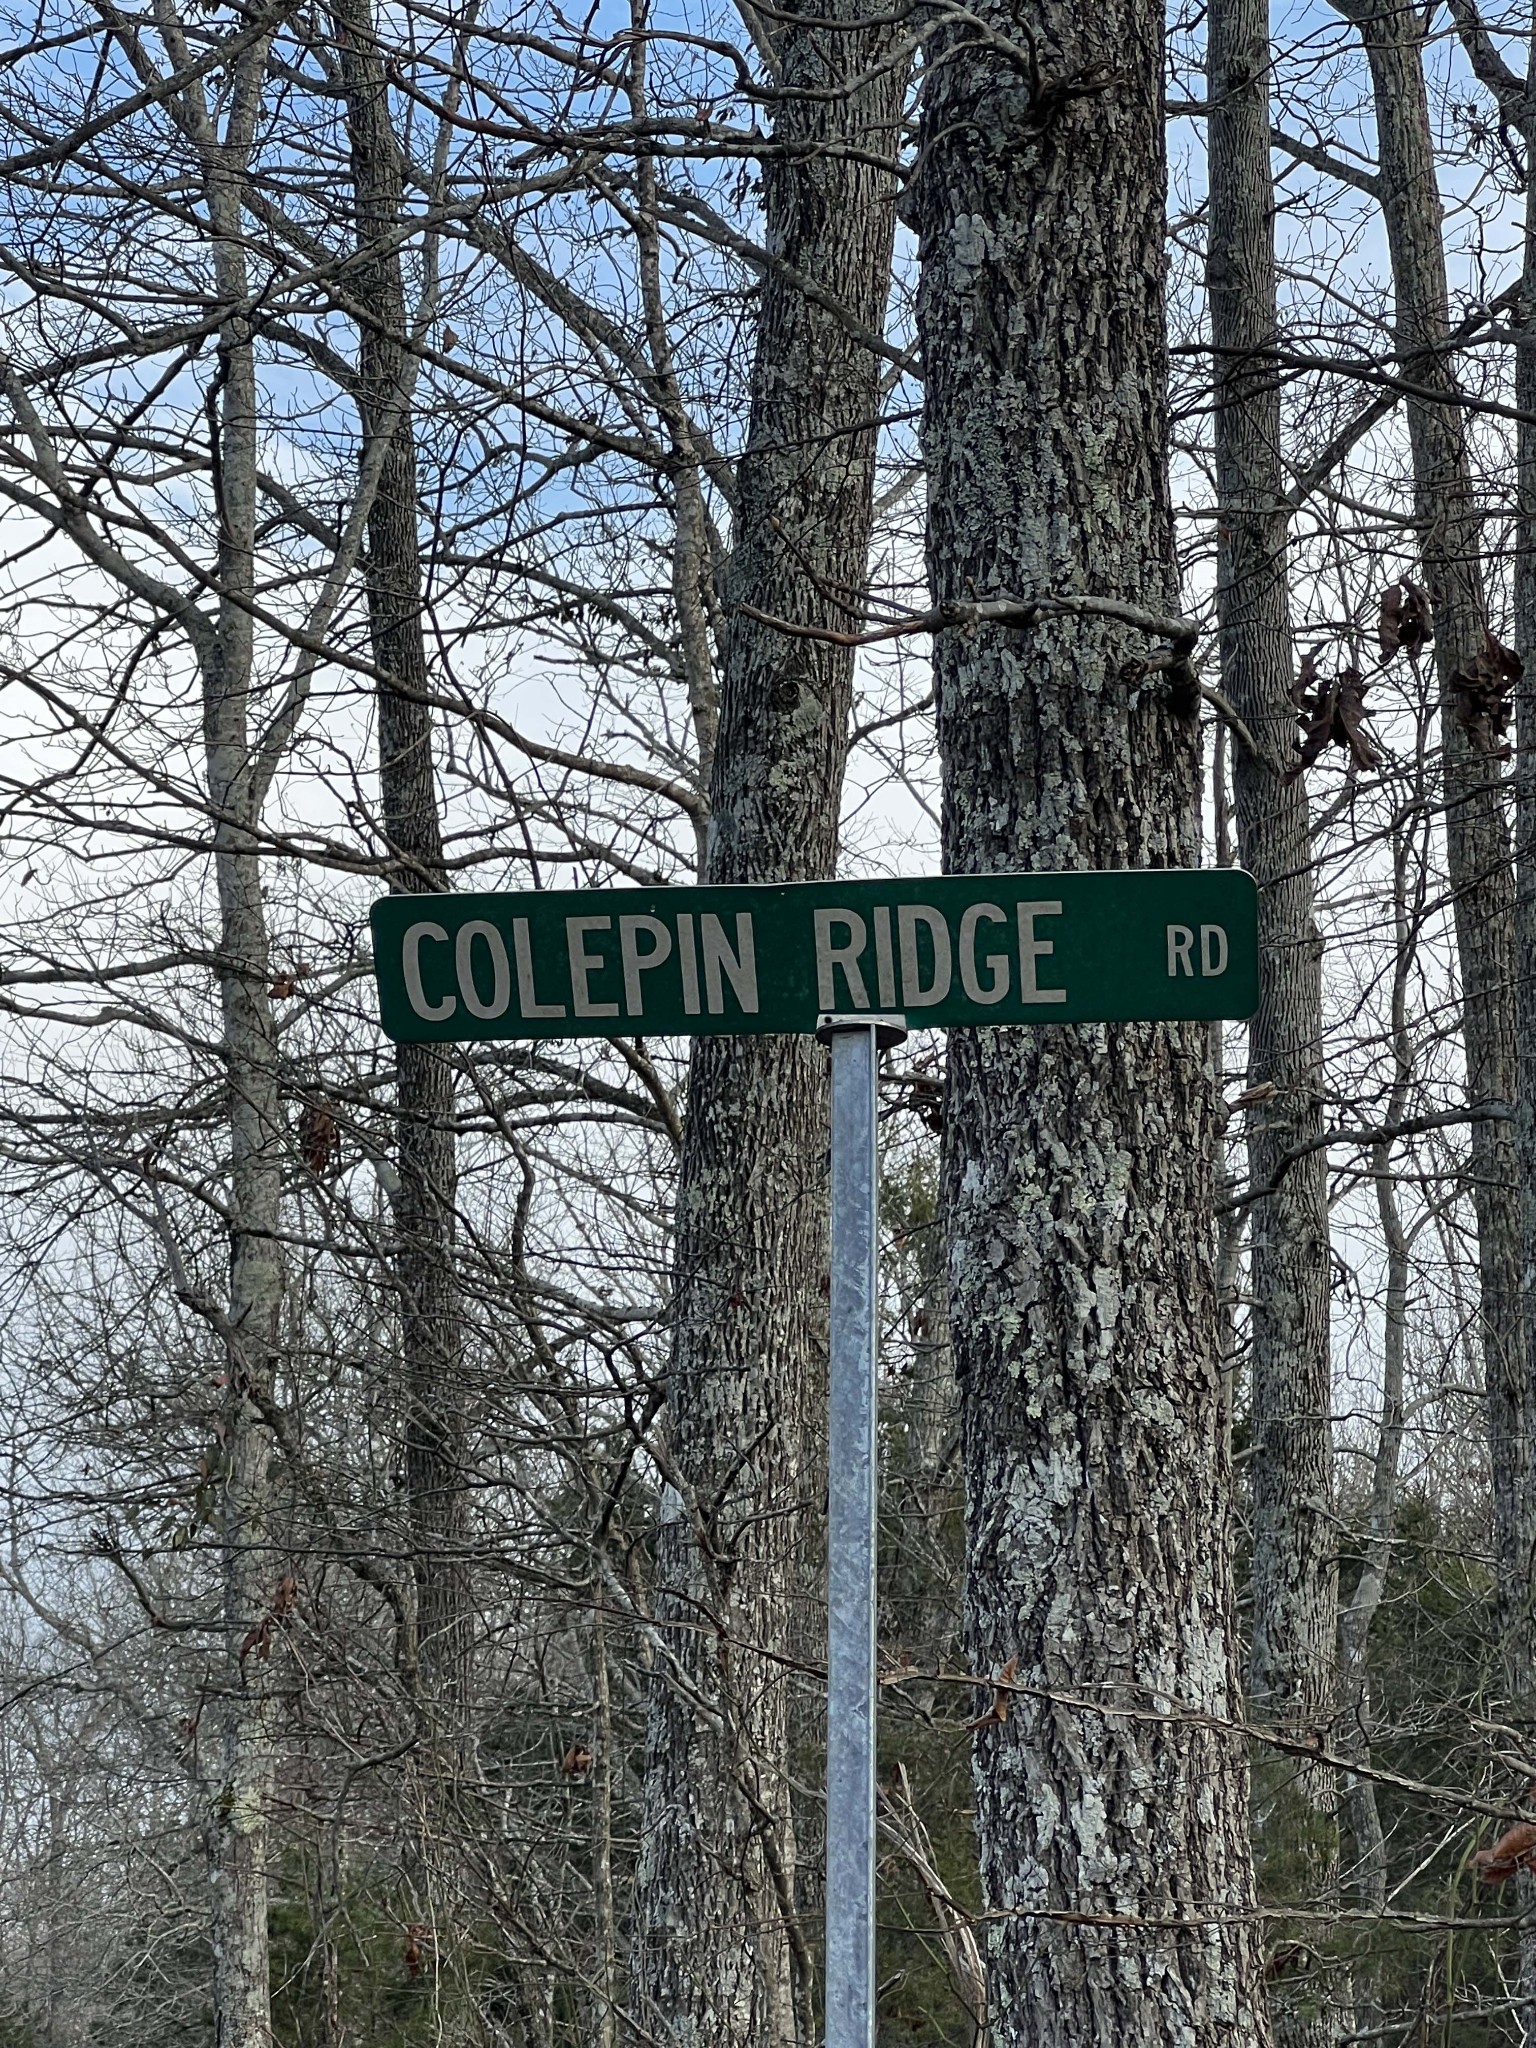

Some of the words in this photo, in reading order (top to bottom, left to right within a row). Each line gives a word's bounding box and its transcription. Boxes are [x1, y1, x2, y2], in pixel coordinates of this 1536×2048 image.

[402, 911, 760, 1022] COLEPIN
[813, 899, 1068, 1011] RIDGE
[1166, 923, 1229, 978] RD
